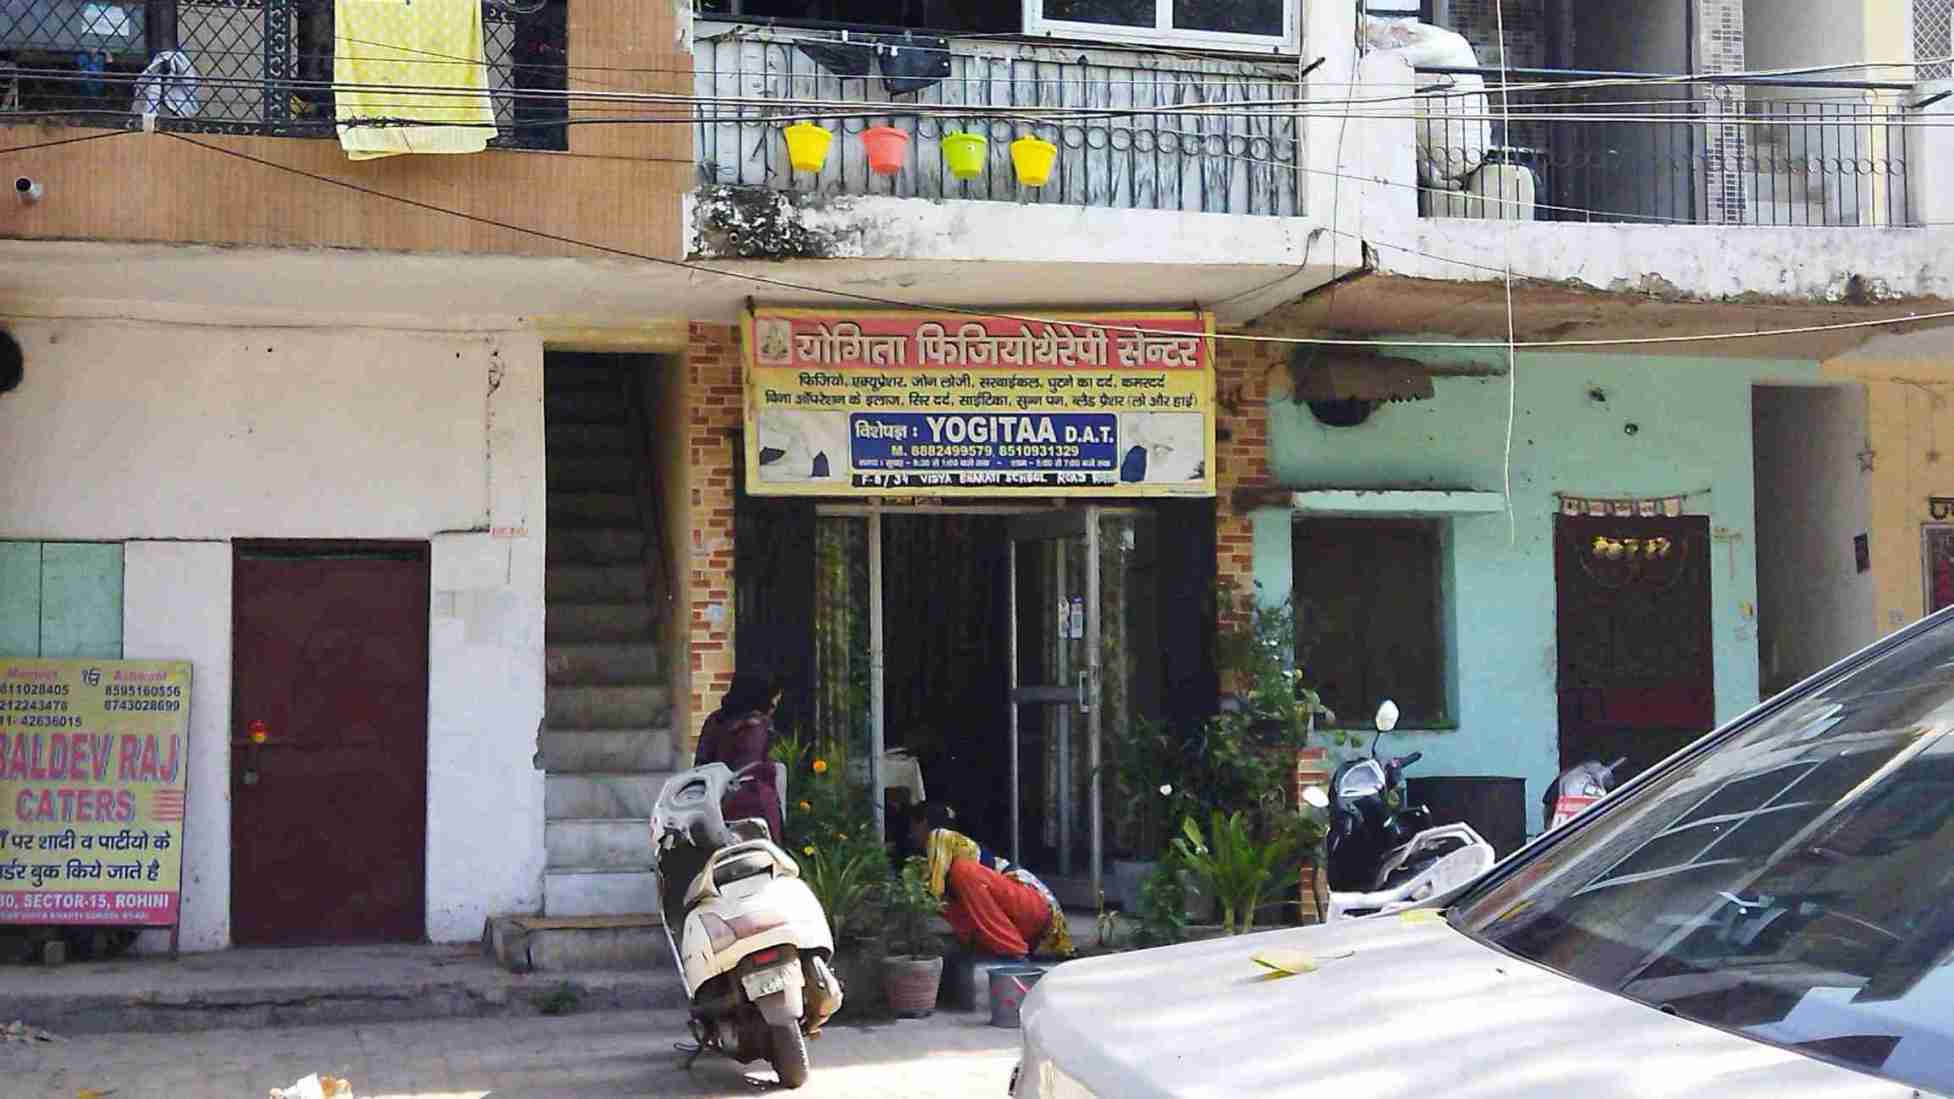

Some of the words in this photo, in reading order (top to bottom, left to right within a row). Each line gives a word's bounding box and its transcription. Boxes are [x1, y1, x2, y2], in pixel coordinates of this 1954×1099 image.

[795, 321, 909, 366] योगिता
[926, 416, 1057, 443] YOGITAA
[1065, 426, 1114, 443] D.A.T.
[119, 732, 181, 785] RAJ
[16, 787, 137, 824] CATERS
[12, 834, 34, 850] पर
[39, 829, 76, 850] शादी
[81, 834, 95, 850] व
[153, 830, 172, 850] के
[31, 863, 61, 887] बुक
[66, 858, 102, 880] किये
[107, 859, 142, 880] जाते
[115, 893, 169, 908] ROHINI
